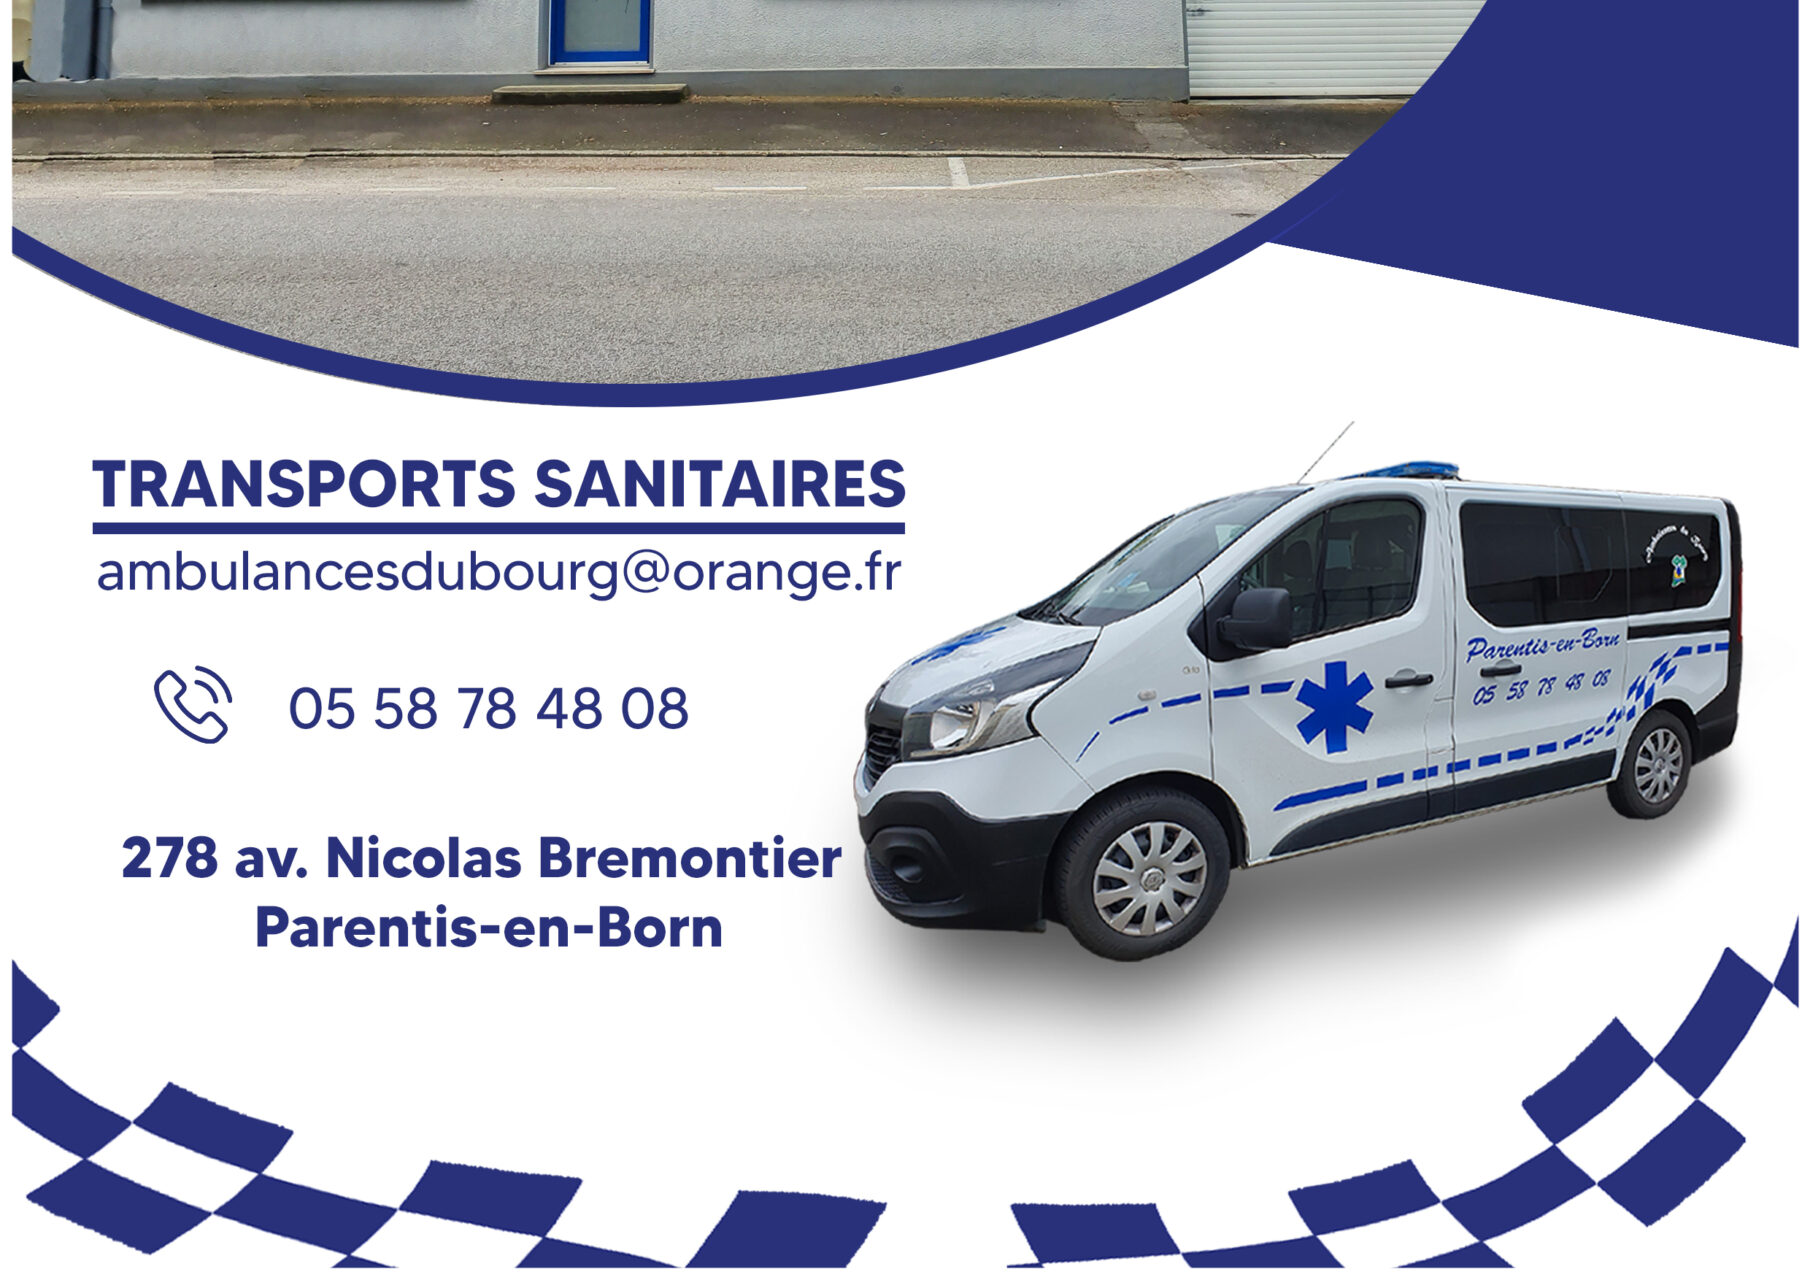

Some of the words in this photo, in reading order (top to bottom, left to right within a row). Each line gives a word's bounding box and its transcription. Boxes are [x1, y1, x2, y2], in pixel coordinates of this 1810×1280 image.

[91, 458, 516, 508] TRANSPORTS
[534, 458, 906, 508] SANITAIRES
[97, 548, 902, 602] ambulancesdubourg@orange.fr
[1466, 626, 1620, 663] Parentis-en-Born
[289, 686, 355, 730] 05
[374, 686, 438, 730] 58
[457, 686, 517, 730] 78
[536, 686, 603, 730] 48
[621, 686, 689, 730] 08
[1473, 684, 1497, 706] 05
[1506, 679, 1529, 701] 58
[1537, 676, 1558, 697] 78
[1565, 672, 1586, 692] 48
[1592, 668, 1612, 688] 08
[122, 835, 218, 879] 278
[235, 843, 308, 879] av.
[327, 834, 522, 879] Nicolas
[540, 834, 843, 879] Bremontier
[256, 903, 722, 948] Parentis-en-Born
